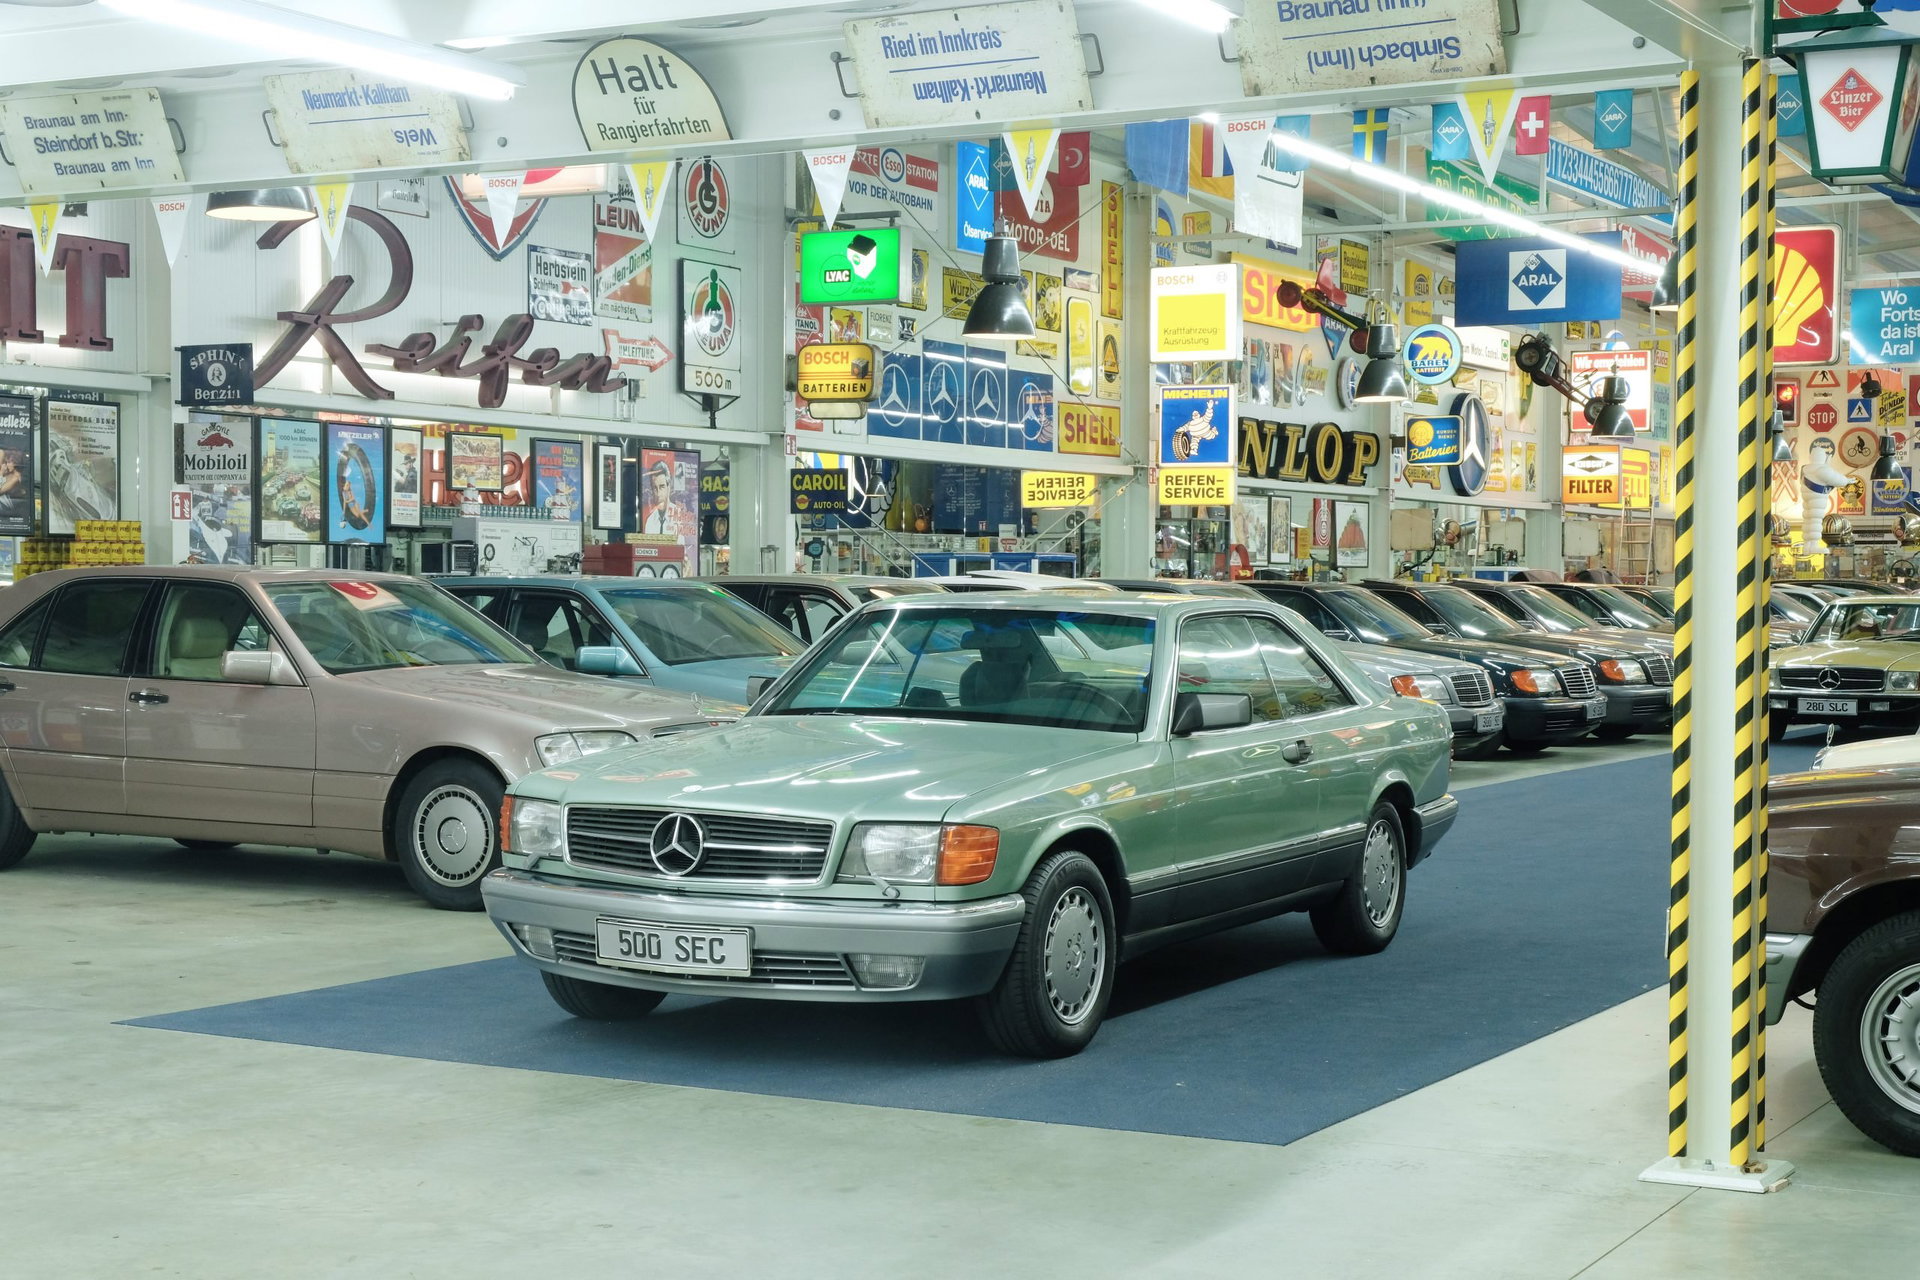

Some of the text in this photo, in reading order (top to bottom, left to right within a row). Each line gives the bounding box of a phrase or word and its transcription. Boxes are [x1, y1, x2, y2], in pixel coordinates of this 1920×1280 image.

[881, 26, 1002, 59] Ried im Innkreis
[1307, 36, 1461, 74] Simbach (Inn)
[590, 54, 678, 95] Halt
[1830, 90, 1873, 105] Linzer
[633, 96, 656, 115] für
[1839, 106, 1863, 117] Bier
[23, 115, 75, 130] Braunau
[80, 112, 101, 125] am
[1228, 120, 1266, 132] BOSCH
[597, 116, 712, 143] Rangierfahrten
[33, 132, 99, 154] Steindorf
[54, 156, 155, 176] Braunau am Inn
[813, 155, 846, 165] BOSCH
[855, 150, 938, 181] TZTE Esso STATION
[489, 179, 517, 187] BOSCH
[969, 174, 988, 190] ARAL
[849, 180, 933, 211] VOR DER AUTOBAHN
[159, 203, 185, 212] BOSCH
[690, 203, 726, 233] LEUNA
[1107, 185, 1119, 318] SHELL
[536, 255, 587, 282] Herbstein
[826, 271, 849, 282] LYAC
[1157, 275, 1194, 286] BOSCH
[1518, 274, 1556, 287] ARAL
[1880, 290, 1908, 305] Wo
[252, 204, 628, 408] Reifen
[1881, 324, 1901, 339] da
[1880, 341, 1914, 356] Aral
[804, 351, 849, 366] BOSCH
[1575, 356, 1592, 369] Wir
[695, 370, 732, 390] 500 m
[194, 385, 241, 400] Benzin
[803, 383, 867, 394] BATTERIEN
[1163, 389, 1228, 399] MICHELIN
[1879, 396, 1906, 415] DUNLOP
[1809, 412, 1836, 425] STOP
[1065, 411, 1116, 447] SHELL
[1408, 443, 1458, 462] Batterien
[184, 453, 247, 471] Mobiloil
[793, 473, 846, 491] CAROIL
[1165, 475, 1224, 486] REIFEN-
[1568, 480, 1613, 494] FILTER
[1164, 488, 1225, 499] SERVICE
[813, 501, 845, 509] AUTO-OIL
[1806, 702, 1848, 712] 280 SLC
[618, 929, 726, 965] 500 SEC
